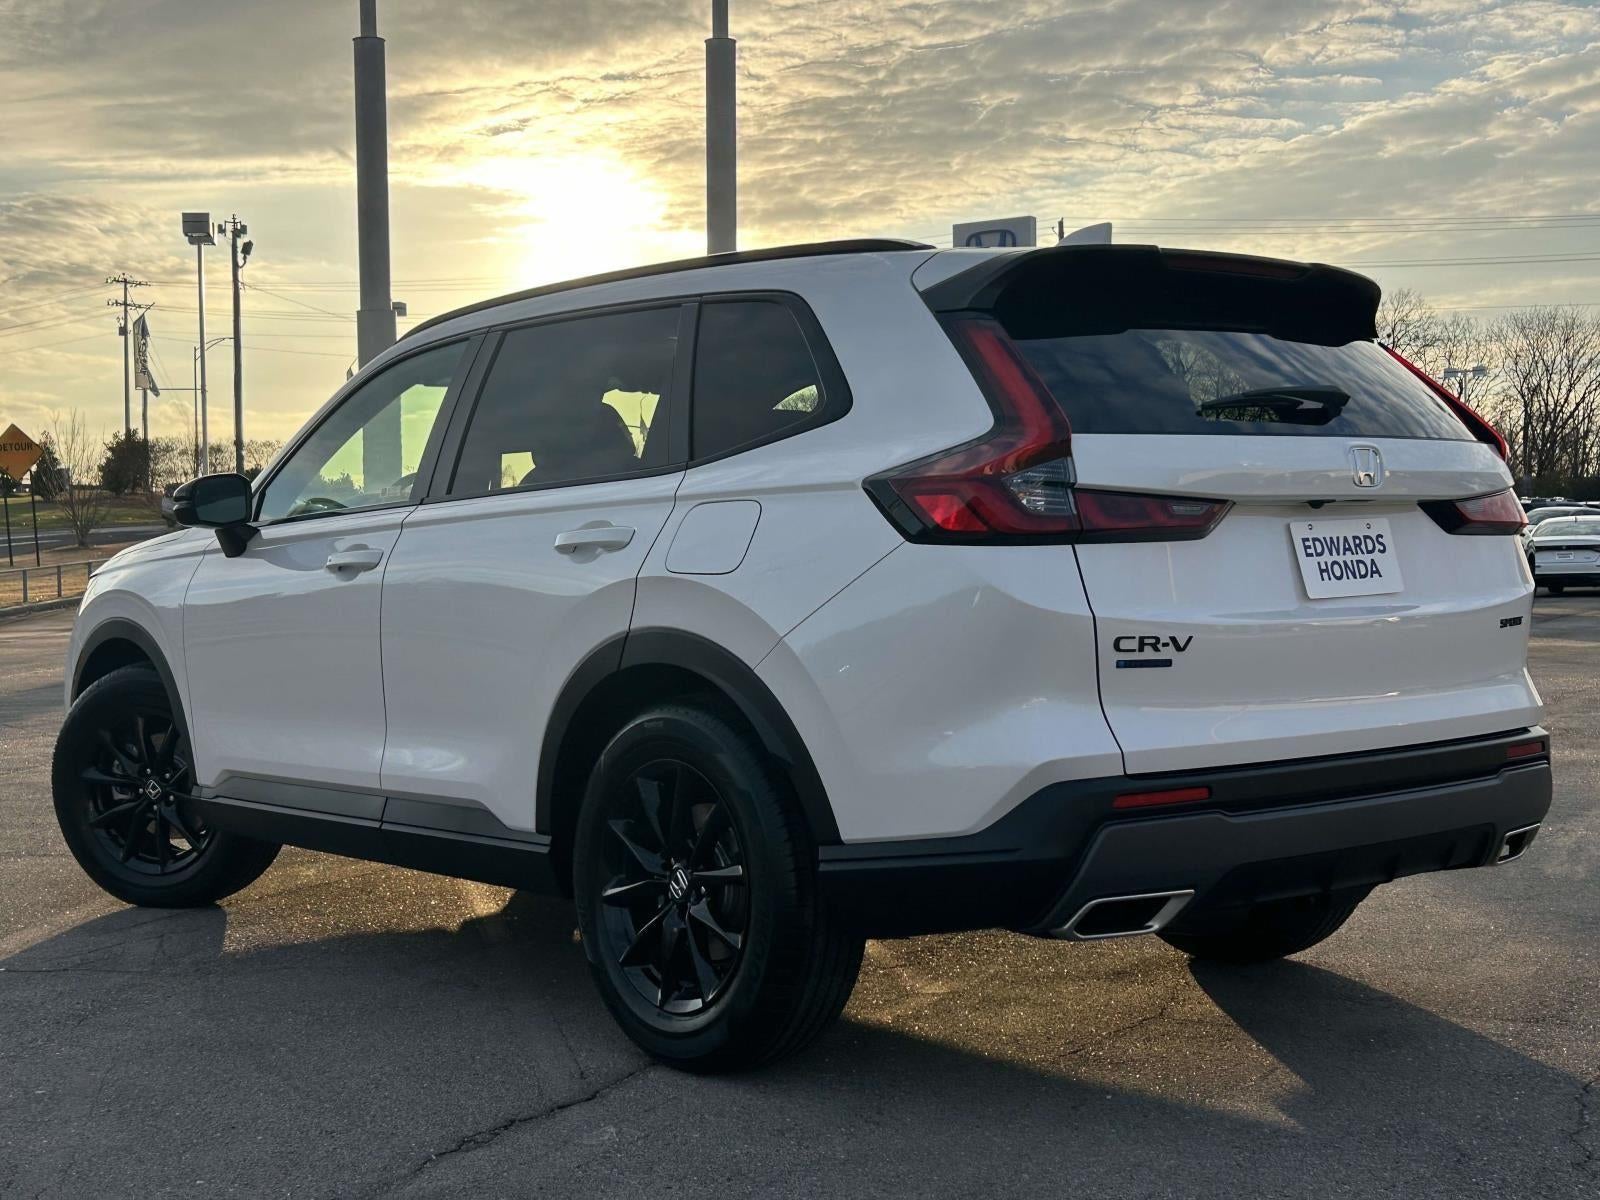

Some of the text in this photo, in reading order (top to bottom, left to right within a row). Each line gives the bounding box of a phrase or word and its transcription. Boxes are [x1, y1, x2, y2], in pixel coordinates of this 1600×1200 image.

[1301, 534, 1387, 557] EDWARDS
[1317, 558, 1383, 581] HONDA
[1113, 636, 1193, 653] CR-V
